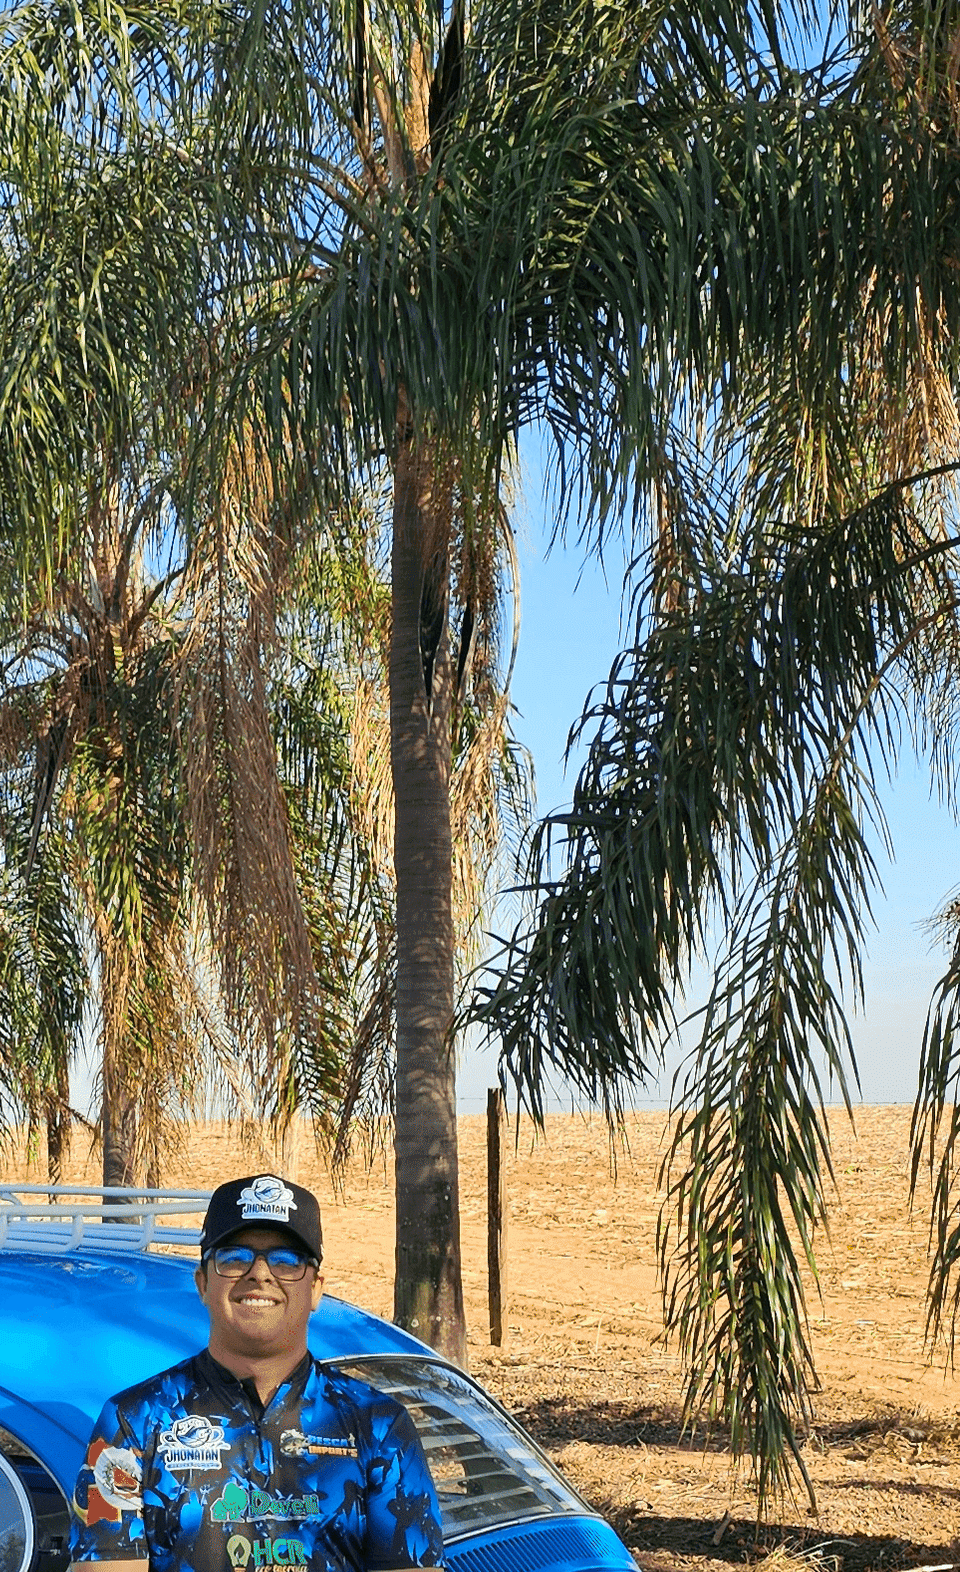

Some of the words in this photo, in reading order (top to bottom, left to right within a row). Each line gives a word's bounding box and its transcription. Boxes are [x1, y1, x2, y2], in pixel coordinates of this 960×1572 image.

[243, 1203, 286, 1215] JHONATAN
[166, 1449, 219, 1462] JHONATAN
[253, 1538, 309, 1566] HCR
